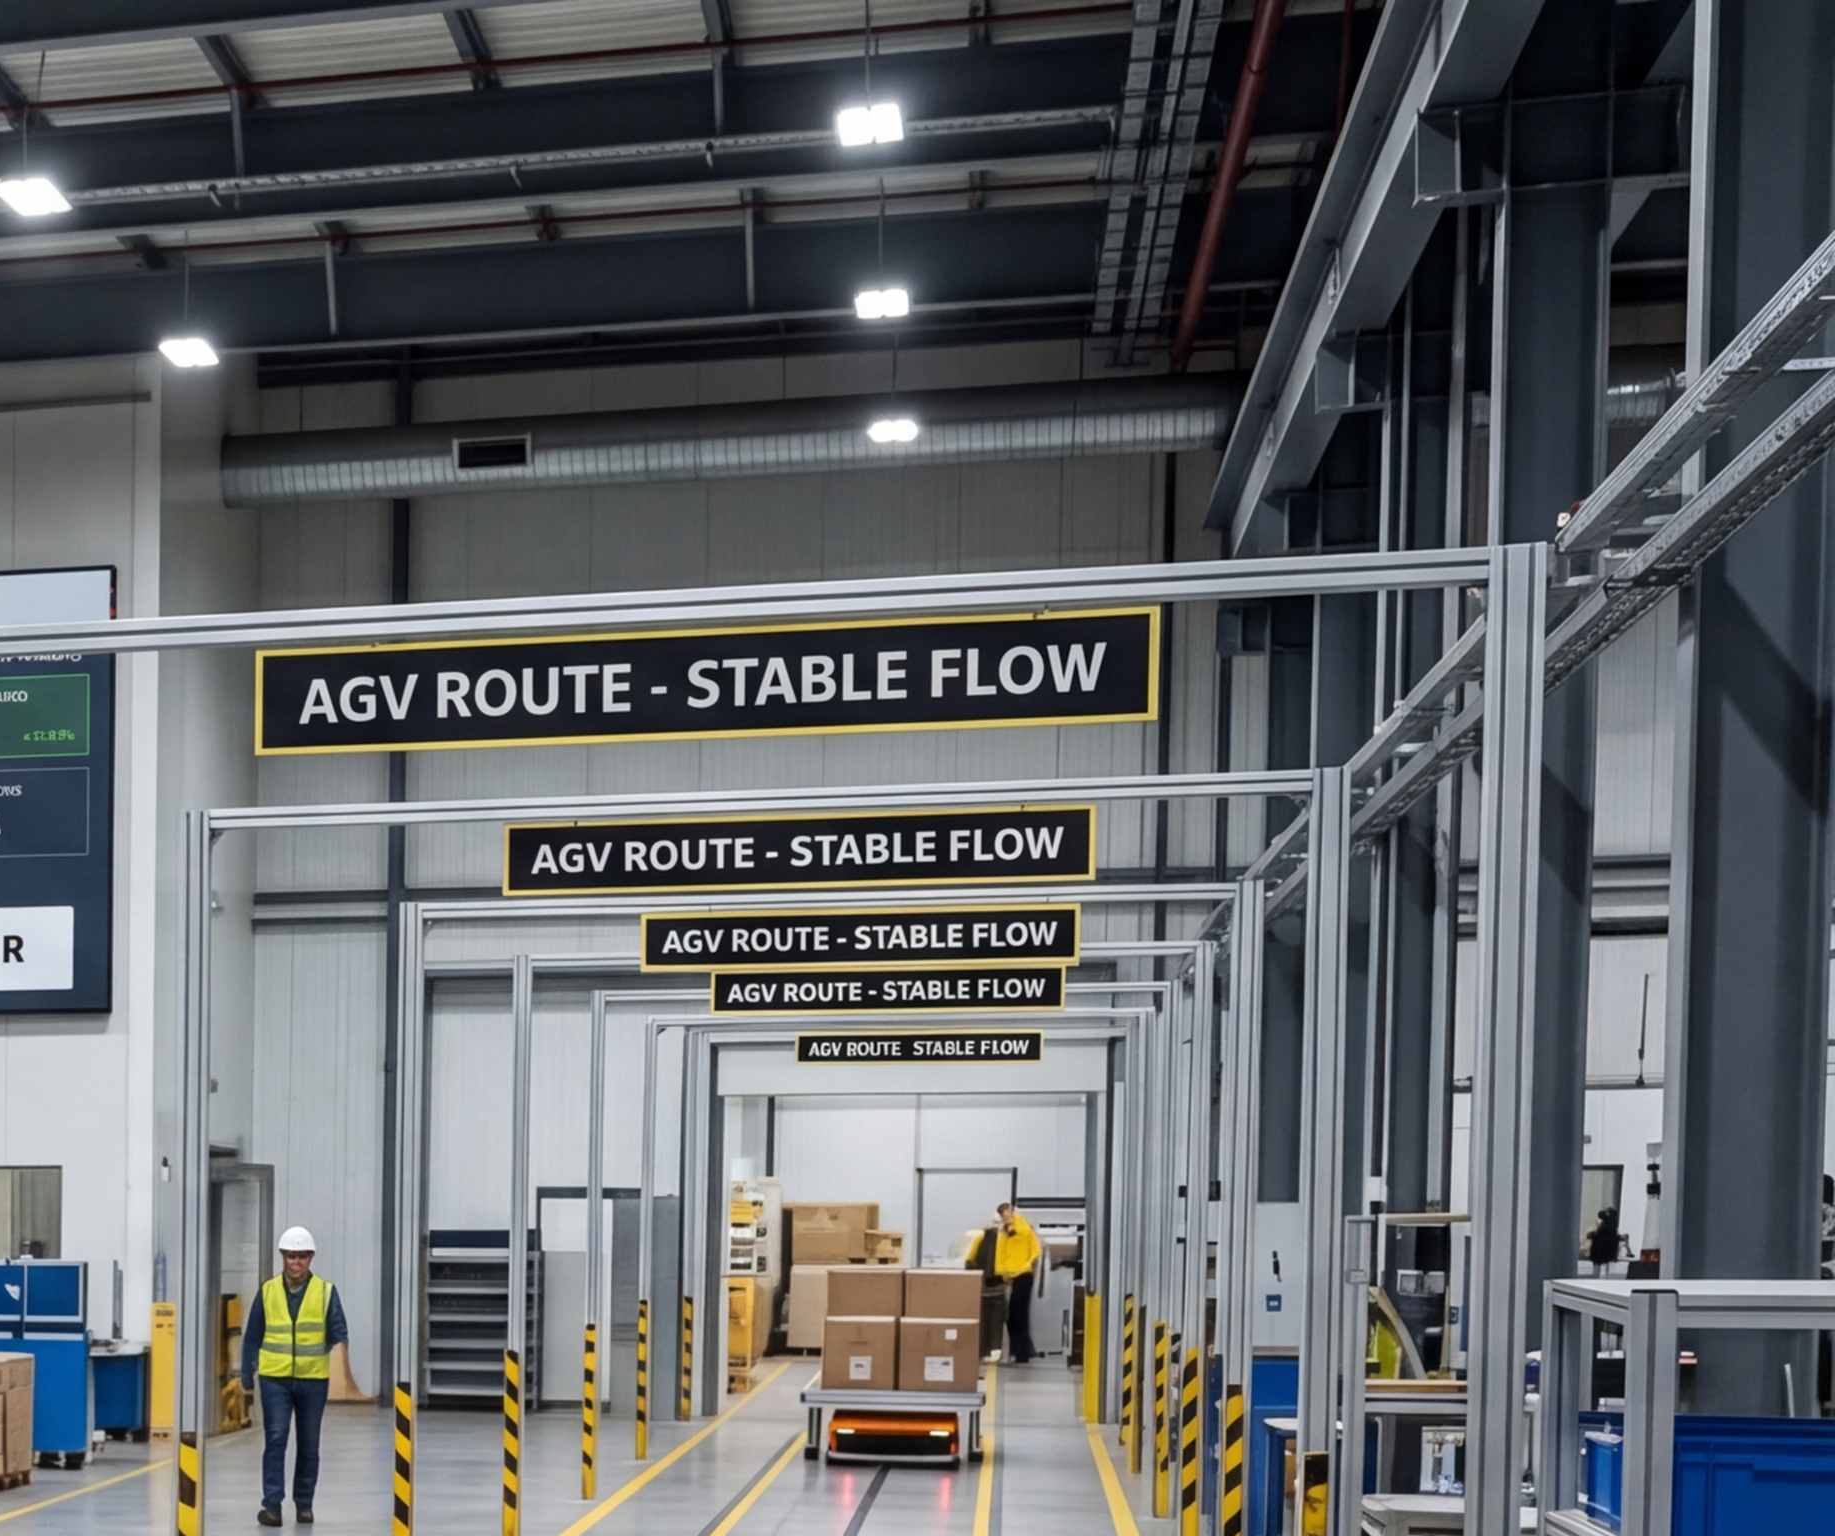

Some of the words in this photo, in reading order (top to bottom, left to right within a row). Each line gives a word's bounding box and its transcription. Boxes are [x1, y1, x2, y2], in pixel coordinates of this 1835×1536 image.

[299, 674, 419, 725] AGV
[435, 663, 633, 719] ROUTE
[651, 686, 667, 696] -
[686, 650, 908, 709] STABLE
[930, 642, 1106, 699] FLOW
[531, 840, 612, 876] AGV
[623, 838, 755, 872] ROUTE
[789, 832, 937, 868] STABLE
[949, 826, 1063, 861] FLOW
[662, 928, 725, 955] AGV
[731, 925, 830, 953] ROUTE
[853, 923, 964, 950] STABLE
[972, 921, 1057, 947] FLOW
[727, 982, 777, 1004] AGV
[783, 981, 862, 1003] ROUTE
[882, 979, 972, 1001] STABLE
[977, 977, 1046, 999] FLOW
[808, 1042, 842, 1057] AGV
[847, 1042, 901, 1057] ROUTE
[913, 1040, 974, 1055] STABLE
[981, 1040, 1029, 1055] FLOW
